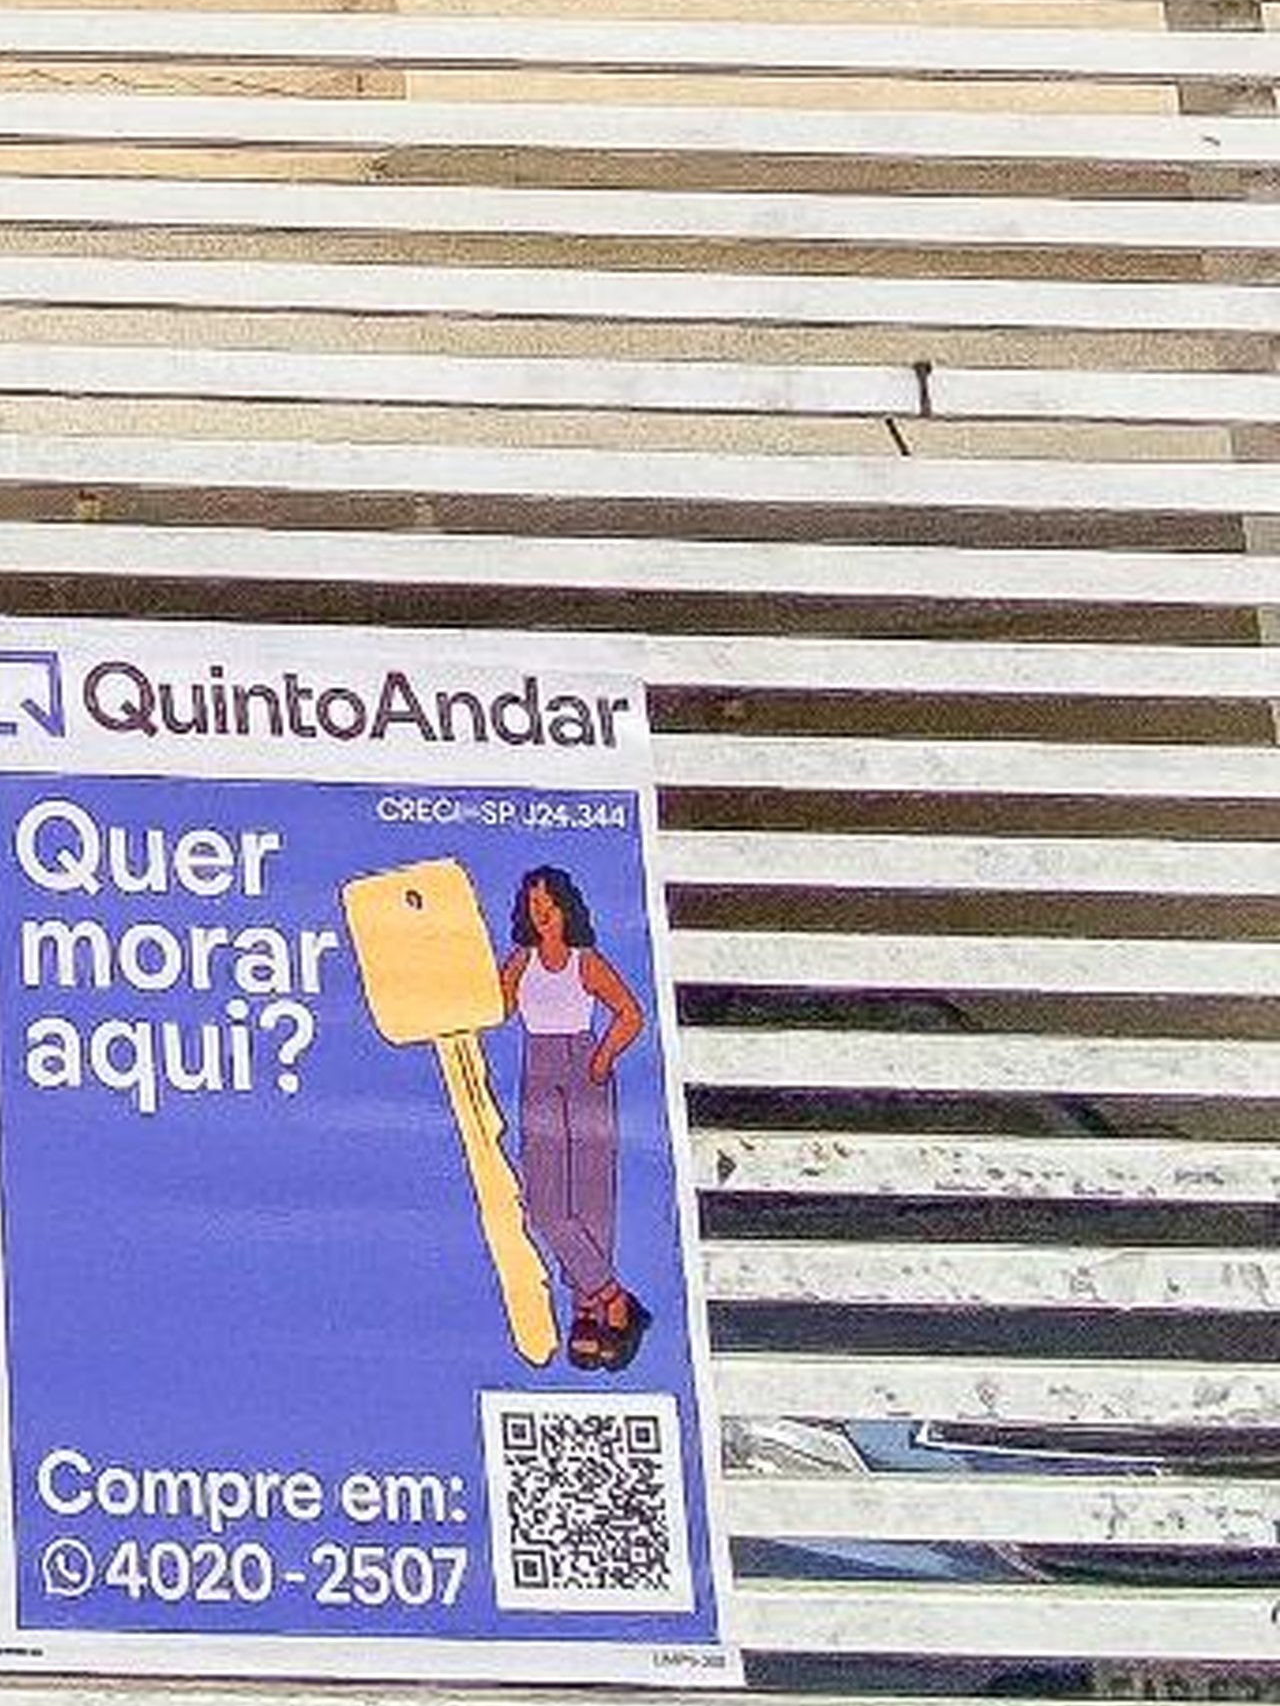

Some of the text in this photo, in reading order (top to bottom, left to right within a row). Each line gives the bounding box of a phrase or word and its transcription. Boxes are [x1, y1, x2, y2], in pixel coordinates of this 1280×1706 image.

[83, 660, 630, 747] QuintoAndar
[14, 798, 281, 897] Quer
[20, 917, 339, 994] morar
[25, 998, 316, 1115] aqui?
[37, 1448, 468, 1532] Compre em:
[103, 1540, 469, 1606] 4020-2507
